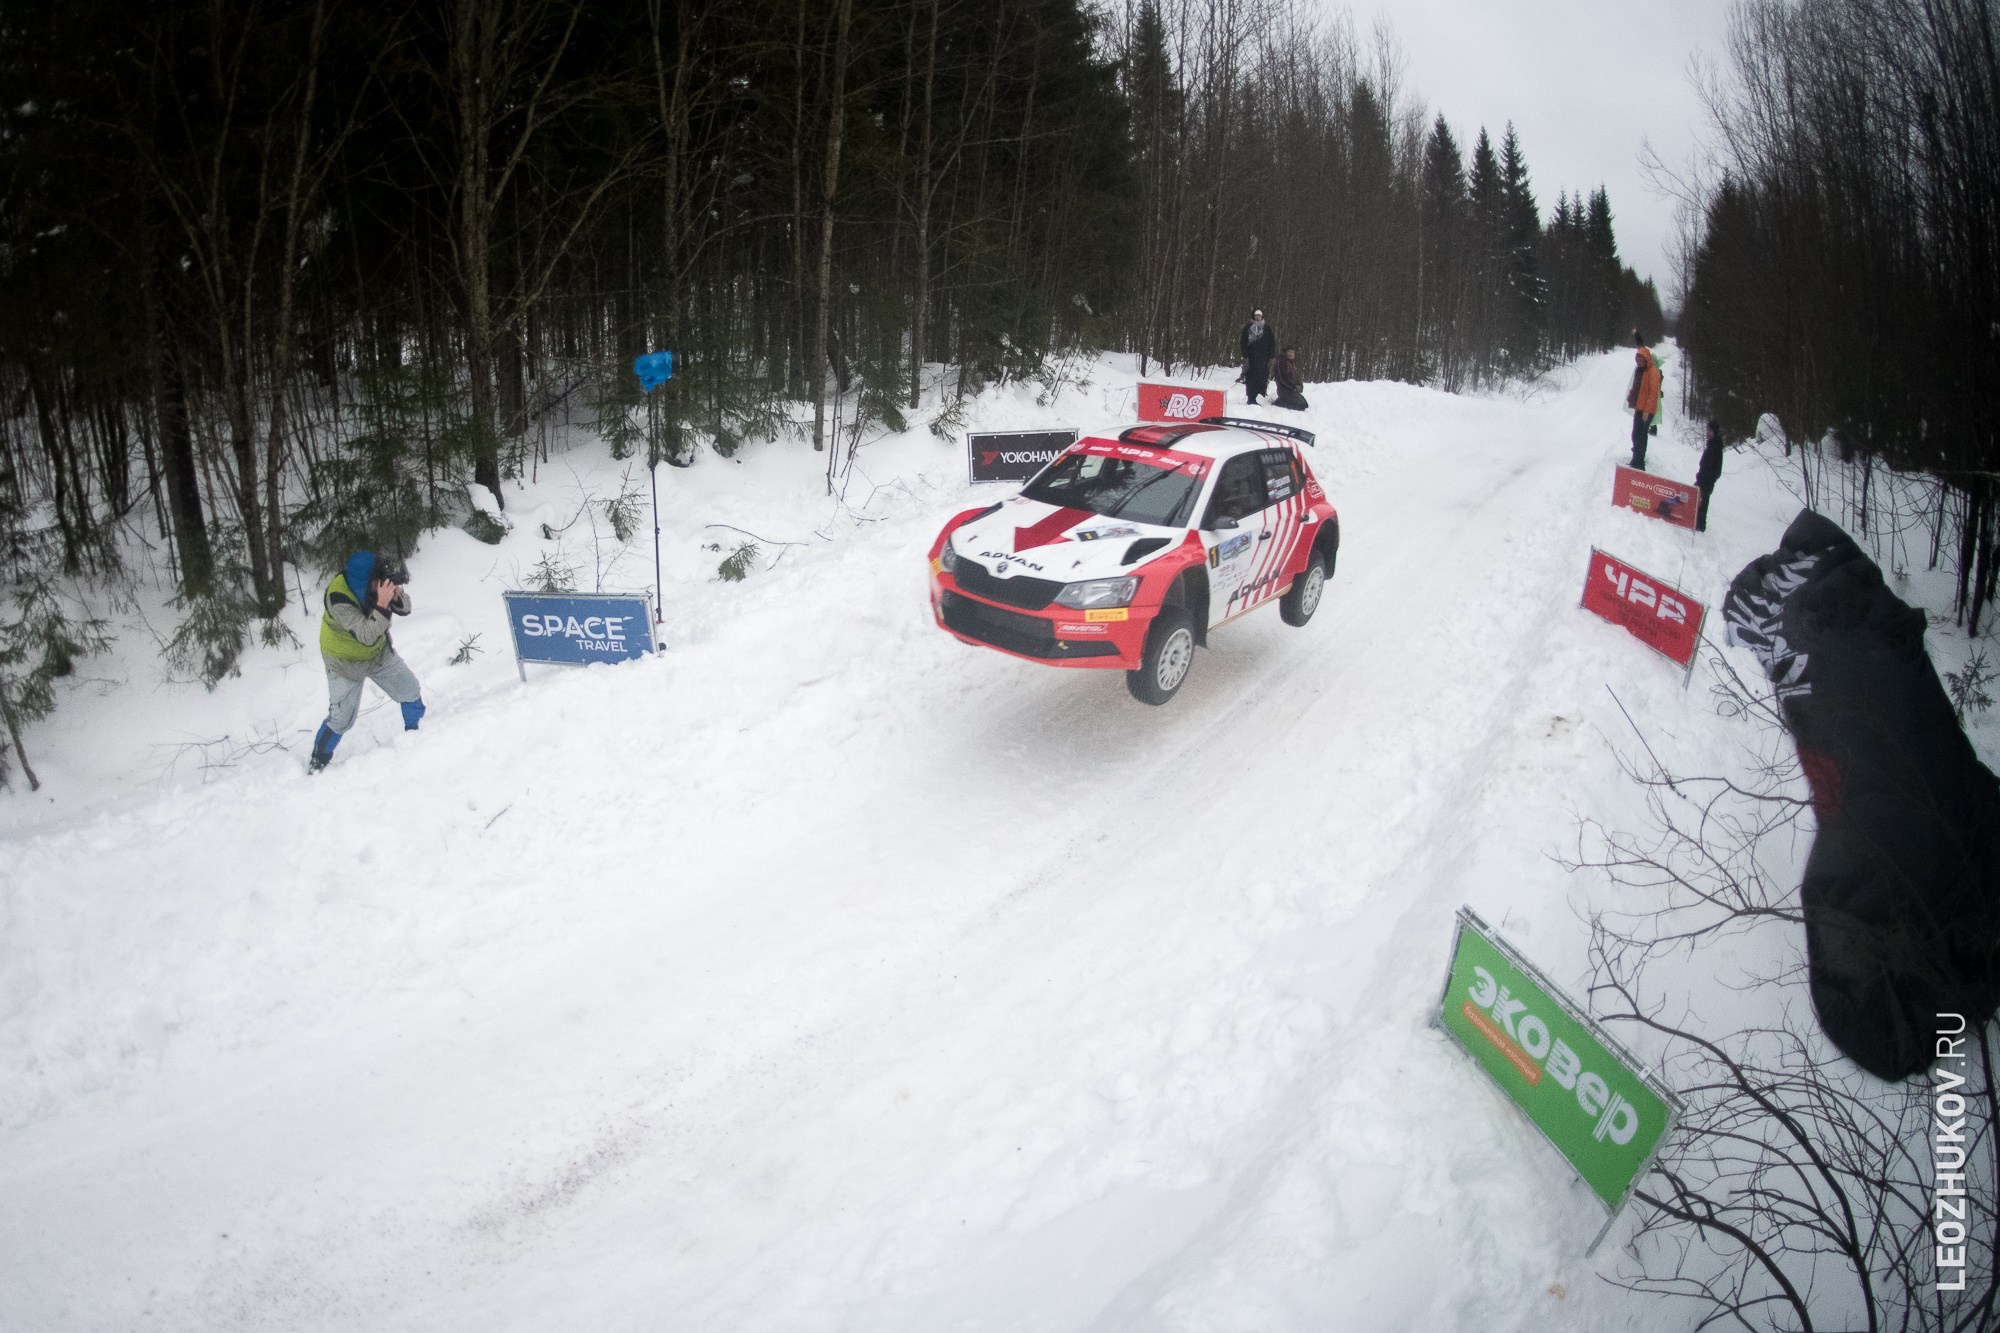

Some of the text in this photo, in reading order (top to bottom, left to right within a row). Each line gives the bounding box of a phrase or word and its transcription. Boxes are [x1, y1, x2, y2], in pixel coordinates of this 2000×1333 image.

[1163, 393, 1205, 419] R8
[979, 551, 1045, 572] ADVAN
[1604, 564, 1686, 624] ЧРР
[522, 614, 626, 640] SPACE
[575, 639, 628, 652] TRAVEL
